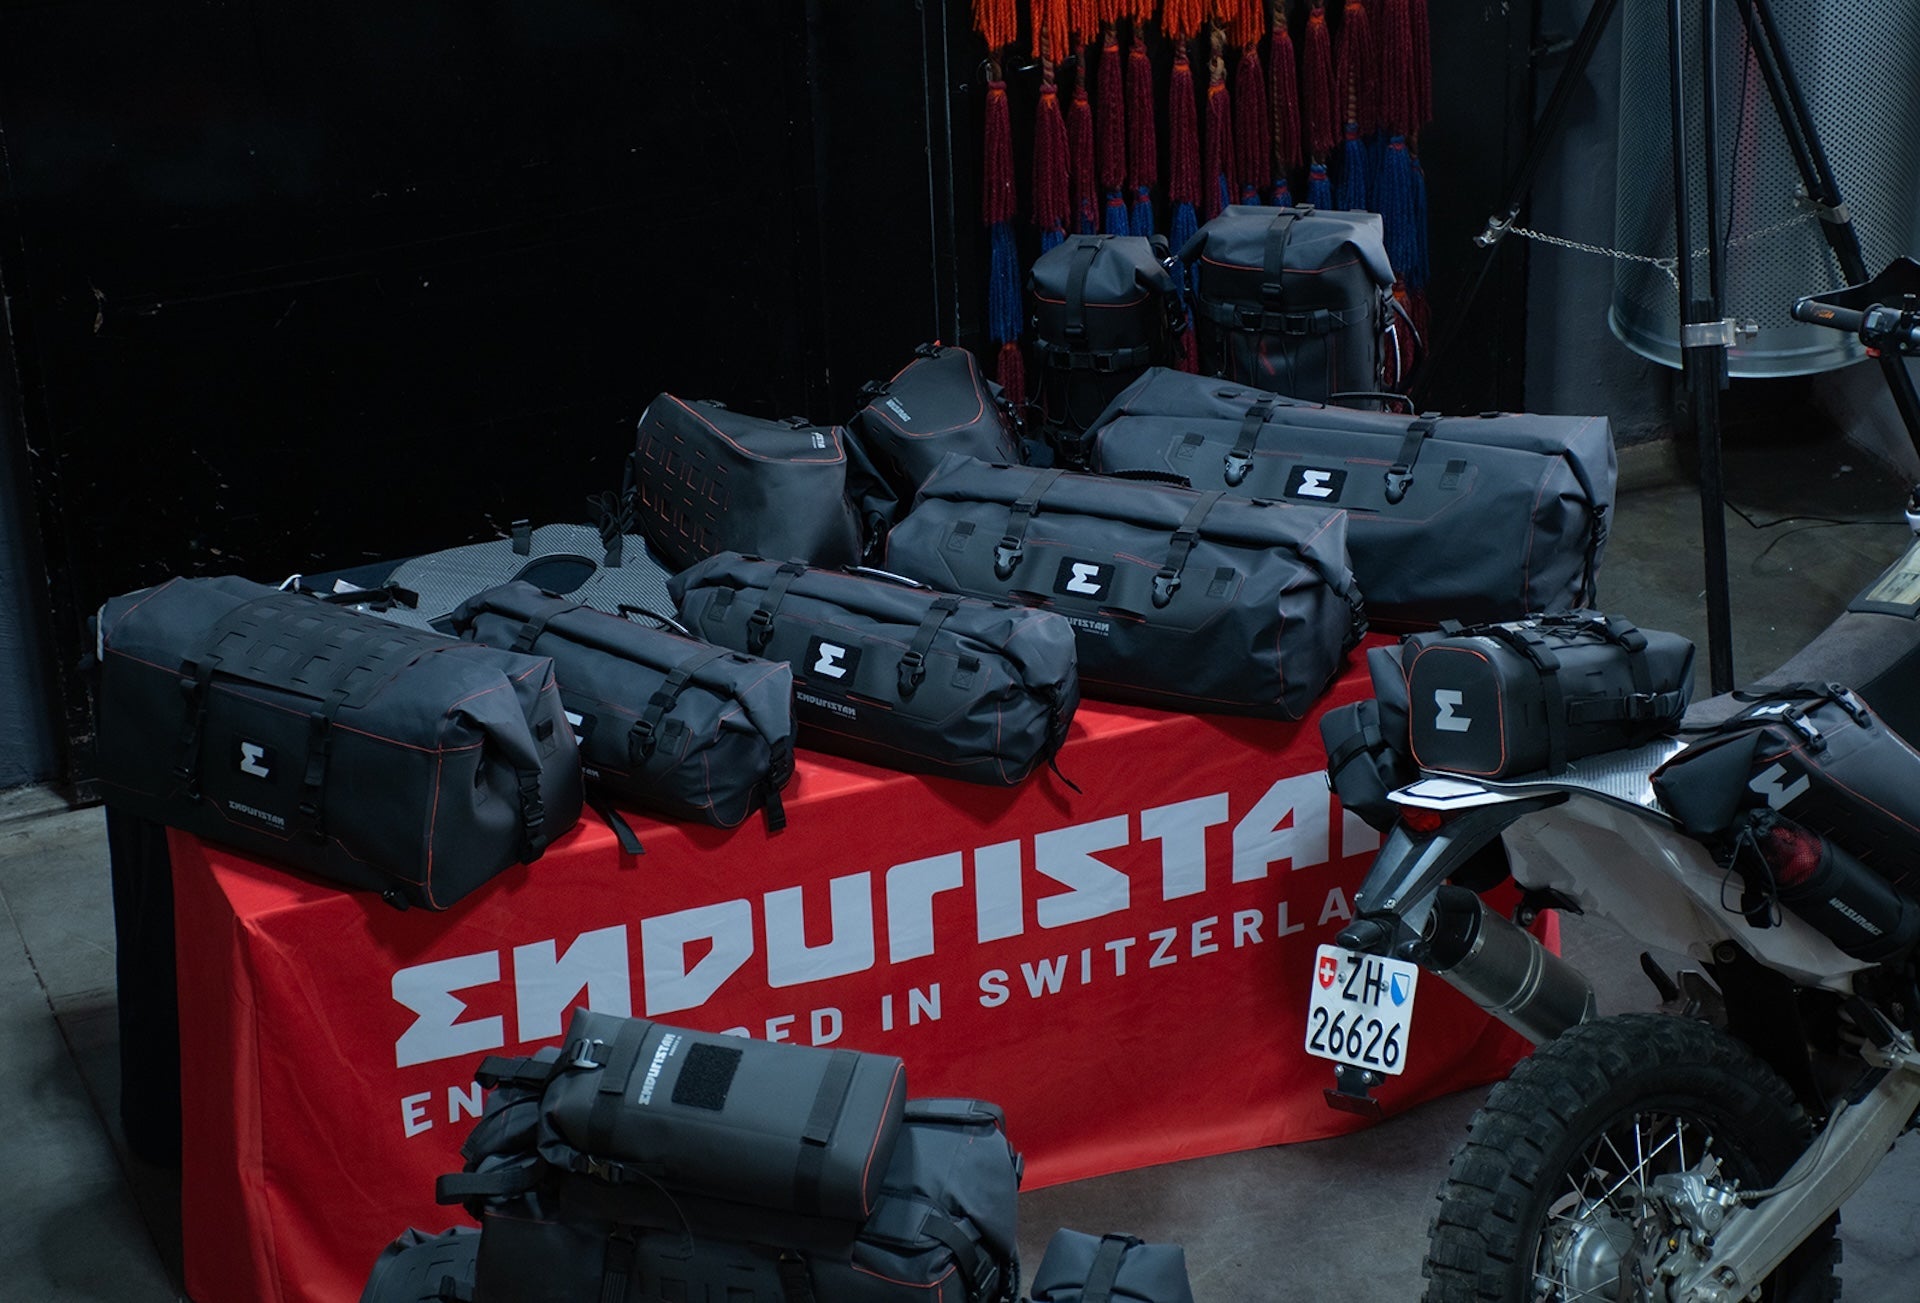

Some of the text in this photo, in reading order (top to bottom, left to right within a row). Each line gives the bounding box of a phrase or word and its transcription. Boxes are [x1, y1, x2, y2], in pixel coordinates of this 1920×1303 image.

[881, 983, 942, 1031] IN
[978, 886, 1354, 1008] SWITZERLA
[1342, 956, 1384, 1006] ZH
[1309, 1006, 1401, 1067] 26626
